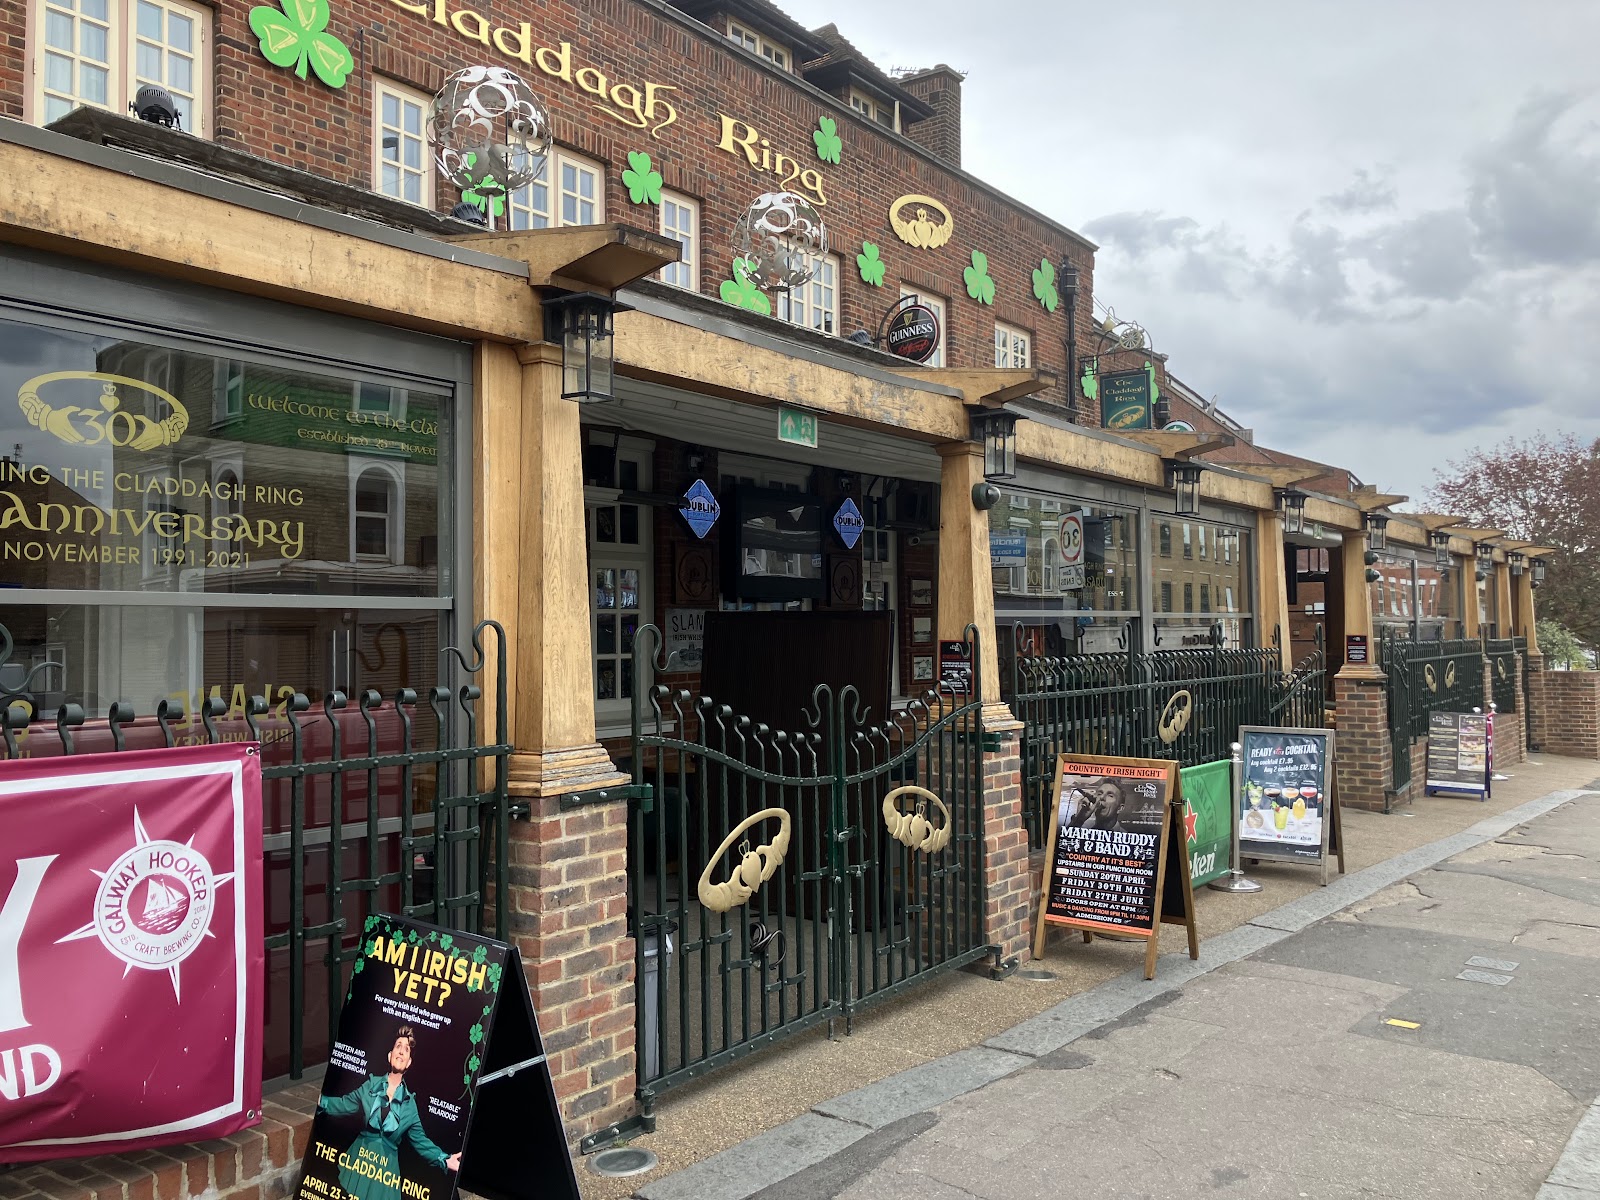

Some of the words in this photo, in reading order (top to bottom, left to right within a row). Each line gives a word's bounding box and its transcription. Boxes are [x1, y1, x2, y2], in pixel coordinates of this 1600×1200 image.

[390, 0, 678, 139] laddagh
[715, 111, 827, 206] Ring
[890, 322, 933, 344] GUINNESS
[1106, 386, 1145, 395] Claddagh
[60, 466, 105, 489] THE
[114, 472, 248, 502] CLADDAGH
[254, 486, 305, 507] RING
[4, 541, 140, 566] NOVEMBER
[151, 549, 250, 569] 1991-2021
[1251, 747, 1274, 758] READY
[1285, 744, 1317, 755] COCKTAIL
[1068, 764, 1105, 774] COUNTRY
[1106, 766, 1111, 774] &
[1113, 767, 1135, 776] IRISH
[1137, 769, 1162, 778] NIGHT
[1251, 760, 1259, 768] Any
[1260, 758, 1278, 766] cocktail
[1060, 826, 1112, 843] MARTIN
[1113, 831, 1158, 847] RUDDY
[1084, 842, 1093, 852] &
[1095, 842, 1131, 857] BAND
[1057, 859, 1085, 868] UPSTAIRS
[1092, 863, 1105, 871] OUR
[1106, 864, 1134, 874] FUNCTION
[1135, 868, 1153, 876] ROOM
[1066, 853, 1100, 863] "COUNTRY
[1124, 859, 1146, 868] BEST"
[1069, 868, 1100, 879] SUNDAY
[1100, 872, 1121, 881] 20TH
[1122, 875, 1146, 885] APRIL
[105, 860, 138, 934] GALWAY
[149, 851, 207, 902] HOOKER
[1062, 877, 1095, 888] FRIDAY
[1098, 882, 1122, 892] 30TH
[1125, 885, 1145, 895] MAY
[1060, 887, 1093, 899] FRIDAY
[1095, 891, 1118, 902] 27TH
[1120, 895, 1144, 905] JUNE
[1066, 898, 1088, 906] DOORS
[1072, 905, 1094, 913] DANCING
[1094, 908, 1109, 916] FROM
[1075, 912, 1112, 922] ADMISSION
[134, 942, 160, 956] CRAFT
[163, 930, 193, 955] BREWING
[368, 936, 408, 967] AM
[410, 946, 419, 970] I
[422, 949, 487, 990] IRISH
[393, 968, 452, 1008] YET?
[375, 994, 384, 1003] For
[384, 998, 398, 1008] every
[398, 1001, 409, 1011] Irish
[410, 1005, 419, 1014] kid
[419, 1009, 430, 1017] who
[430, 1013, 444, 1022] grew
[444, 1017, 451, 1025] up
[383, 1006, 394, 1015] with
[402, 1012, 420, 1023] English
[421, 1019, 440, 1030] accent!
[332, 1049, 360, 1064] PERFORMED
[334, 1041, 354, 1054] WRITTEN
[354, 1049, 365, 1058] AND
[330, 1057, 342, 1067] KATE
[342, 1062, 366, 1076] KERRIGAN
[428, 1105, 459, 1122] "HILARIOUS"
[429, 1096, 462, 1114] "RELATABLE"
[358, 1147, 379, 1163] BACK
[380, 1158, 388, 1168] IN
[315, 1142, 338, 1163] THE
[338, 1152, 401, 1190] CLADDAGH
[402, 1178, 430, 1200] RING
[303, 1175, 328, 1198] APRIL
[330, 1186, 341, 1200] 23
